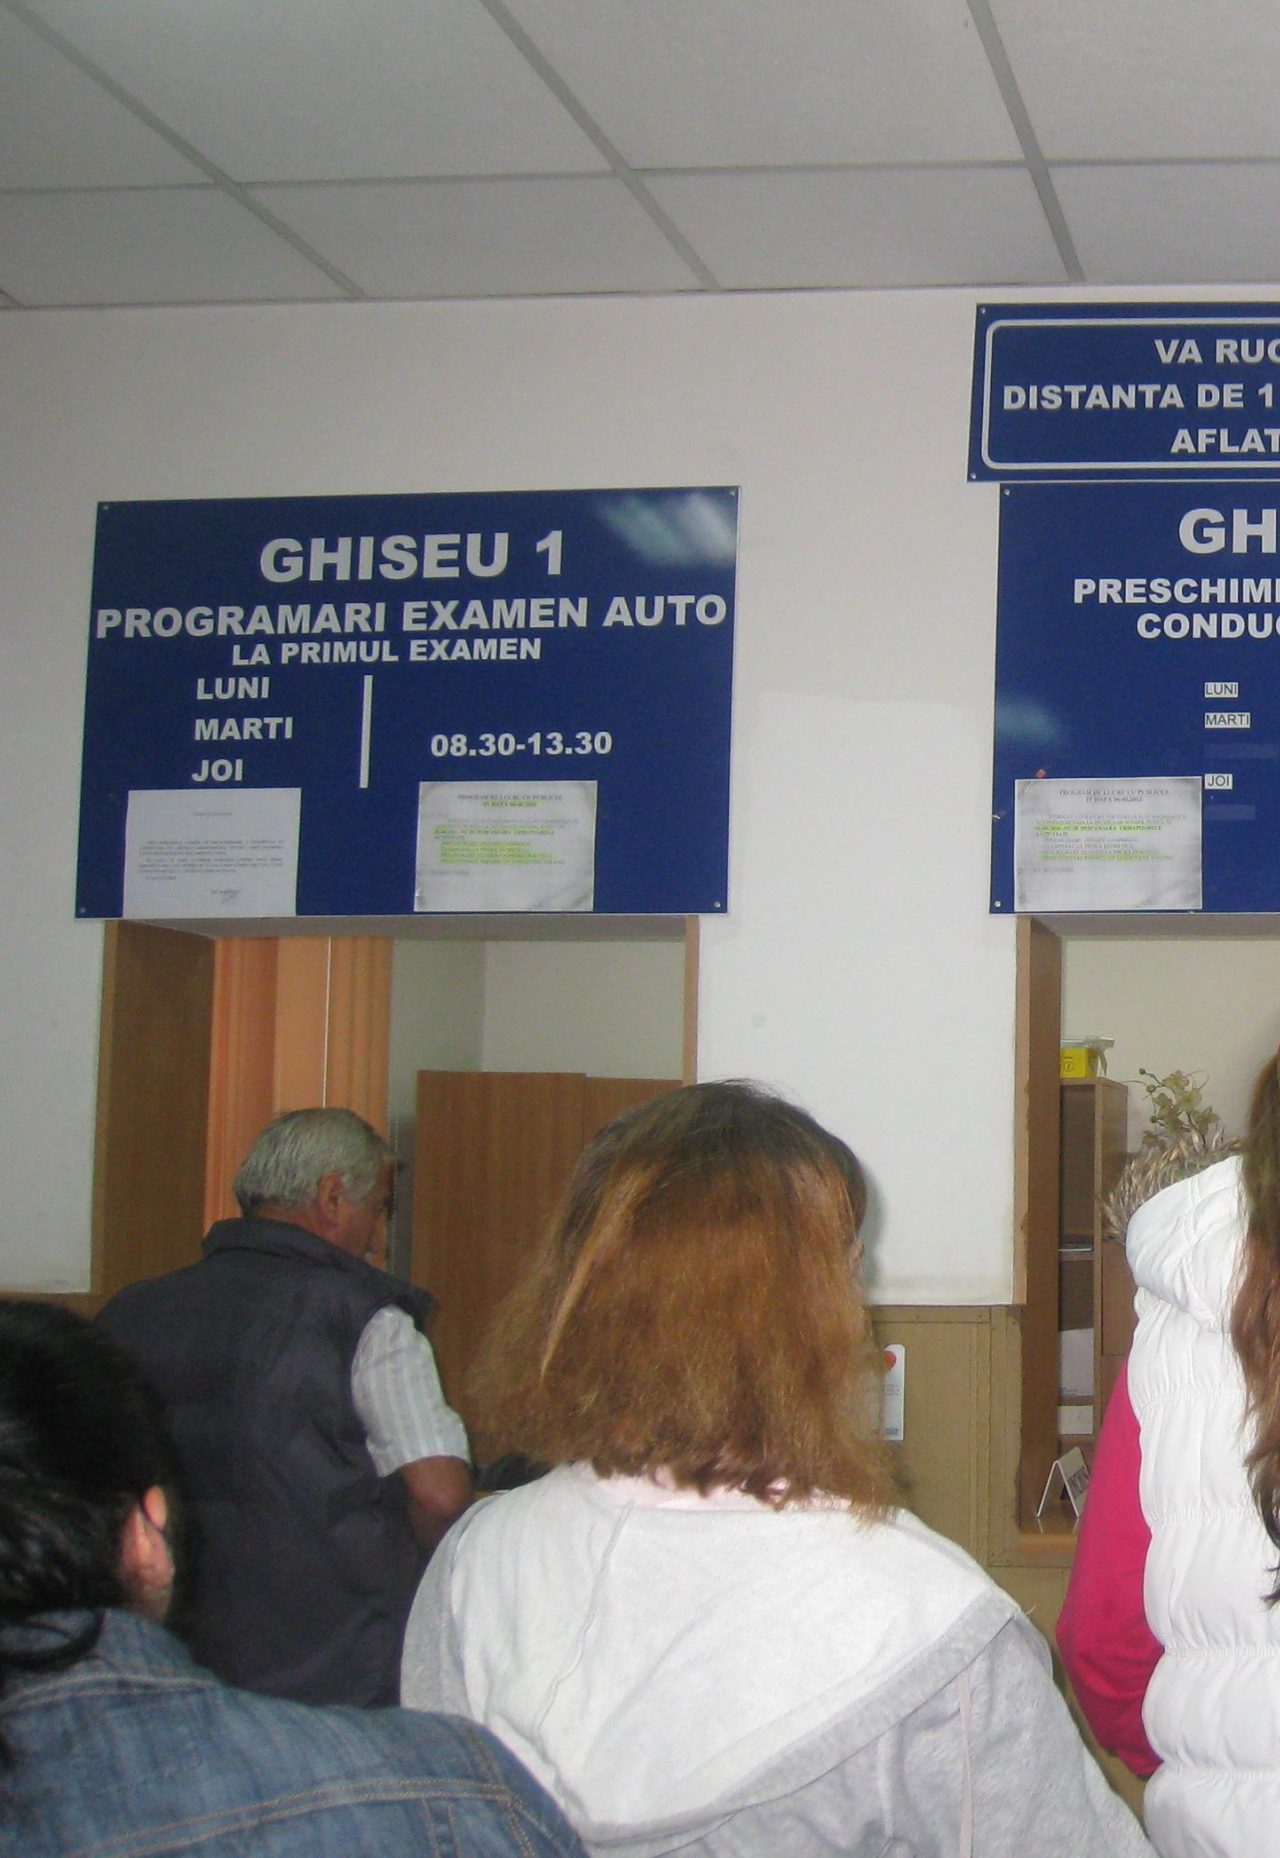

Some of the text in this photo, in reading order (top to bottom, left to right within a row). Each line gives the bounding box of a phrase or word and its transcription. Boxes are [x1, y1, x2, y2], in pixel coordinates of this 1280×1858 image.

[1154, 339, 1203, 364] VA
[1003, 383, 1185, 410] DISTANTA
[1197, 383, 1244, 409] DE
[1258, 383, 1273, 408] 1
[259, 530, 563, 583] GHISEU 1
[96, 594, 727, 639] PROGRAMARI EXAMEN AUTO
[232, 637, 542, 666] LA PRIMUL EXAMEN
[196, 676, 270, 700] LUNI
[1205, 682, 1238, 696] LUNI
[194, 716, 293, 741] MARTI
[1205, 713, 1250, 727] MARTI
[430, 731, 613, 757] 08.30-13.30
[191, 758, 243, 782] JOI
[1207, 774, 1231, 788] JOI
